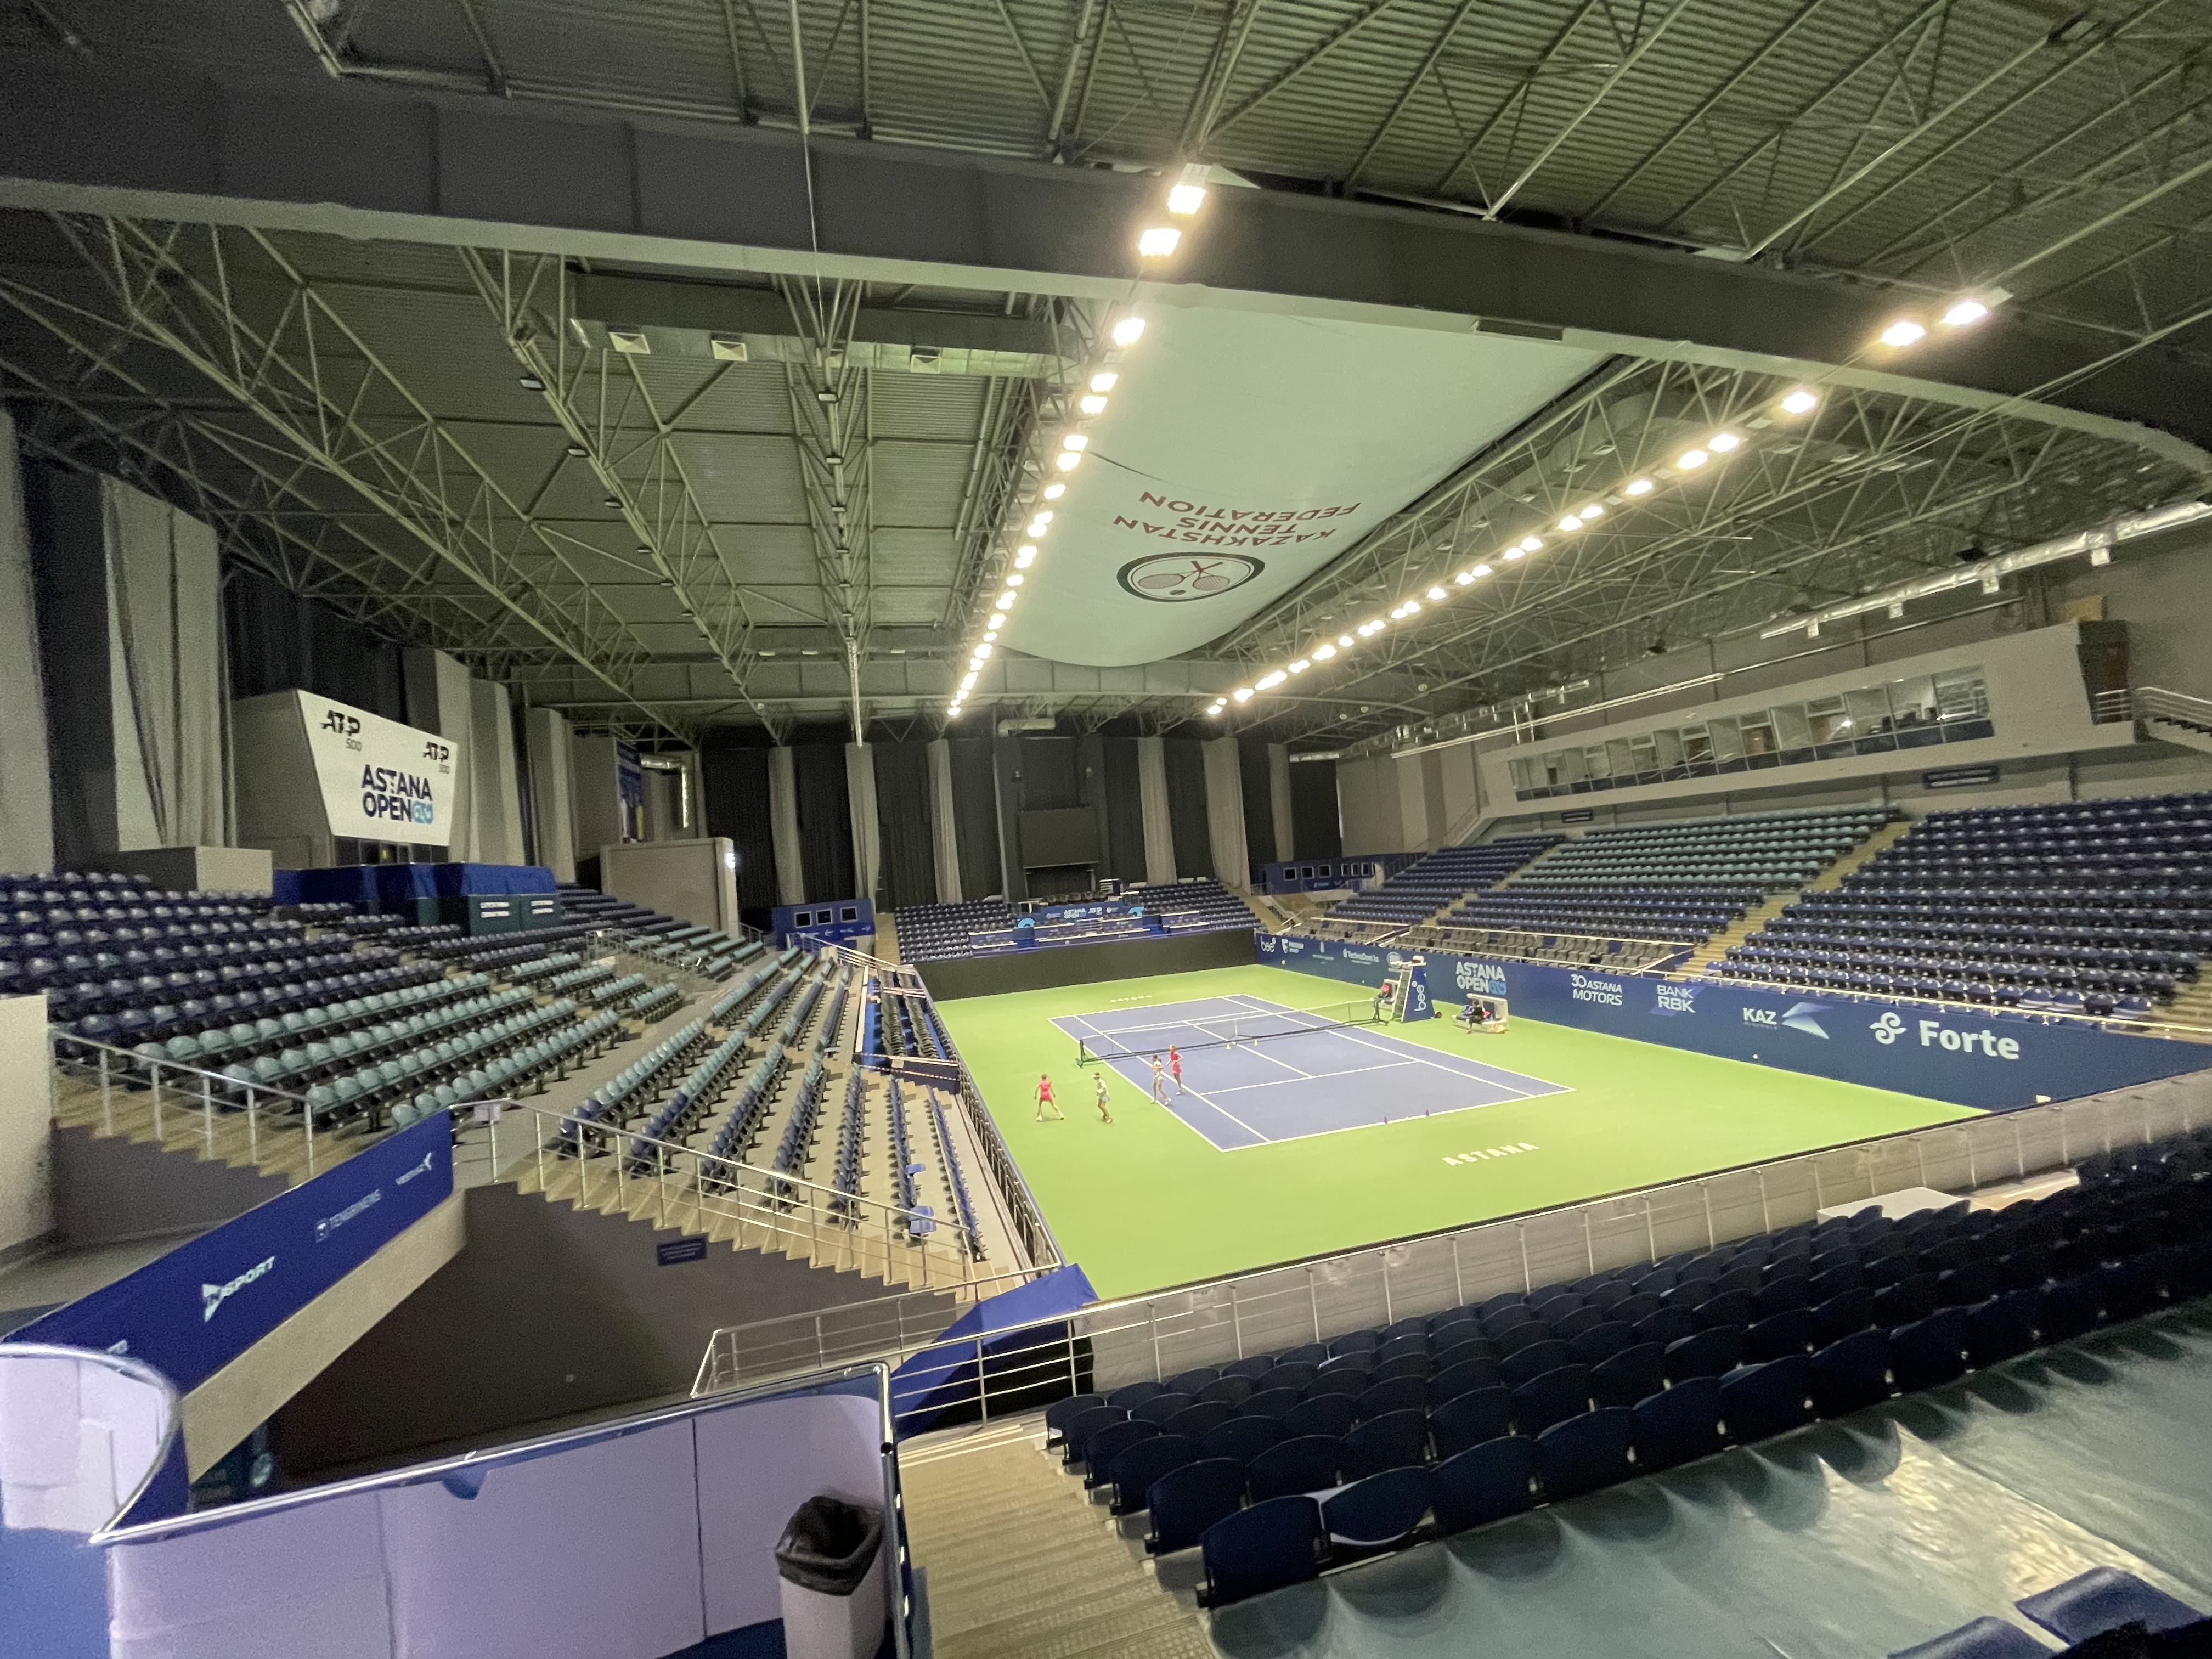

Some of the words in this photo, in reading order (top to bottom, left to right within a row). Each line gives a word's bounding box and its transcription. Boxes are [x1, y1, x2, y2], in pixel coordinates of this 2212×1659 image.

[1139, 492, 1362, 521] FEDERATION
[1113, 515, 1338, 546] KAZAKHSTAN
[1176, 517, 1299, 534] TENNIS
[320, 710, 361, 736] ATP
[422, 741, 449, 762] ATP
[361, 764, 433, 801] ASTANA
[363, 792, 412, 822] OPEN
[1455, 961, 1505, 981] ASTANA
[1457, 975, 1489, 994] OPEN
[1571, 974, 1587, 988] 30
[1587, 980, 1622, 994] ASTANA
[1657, 985, 1694, 998] BANK
[1414, 984, 1426, 1012] bee
[1573, 989, 1622, 1006] MOTORS
[1658, 996, 1696, 1013] RBK
[1743, 1007, 1777, 1025] KAZ
[1919, 1020, 2020, 1059] Forte
[1442, 1142, 1540, 1166] ASTANA
